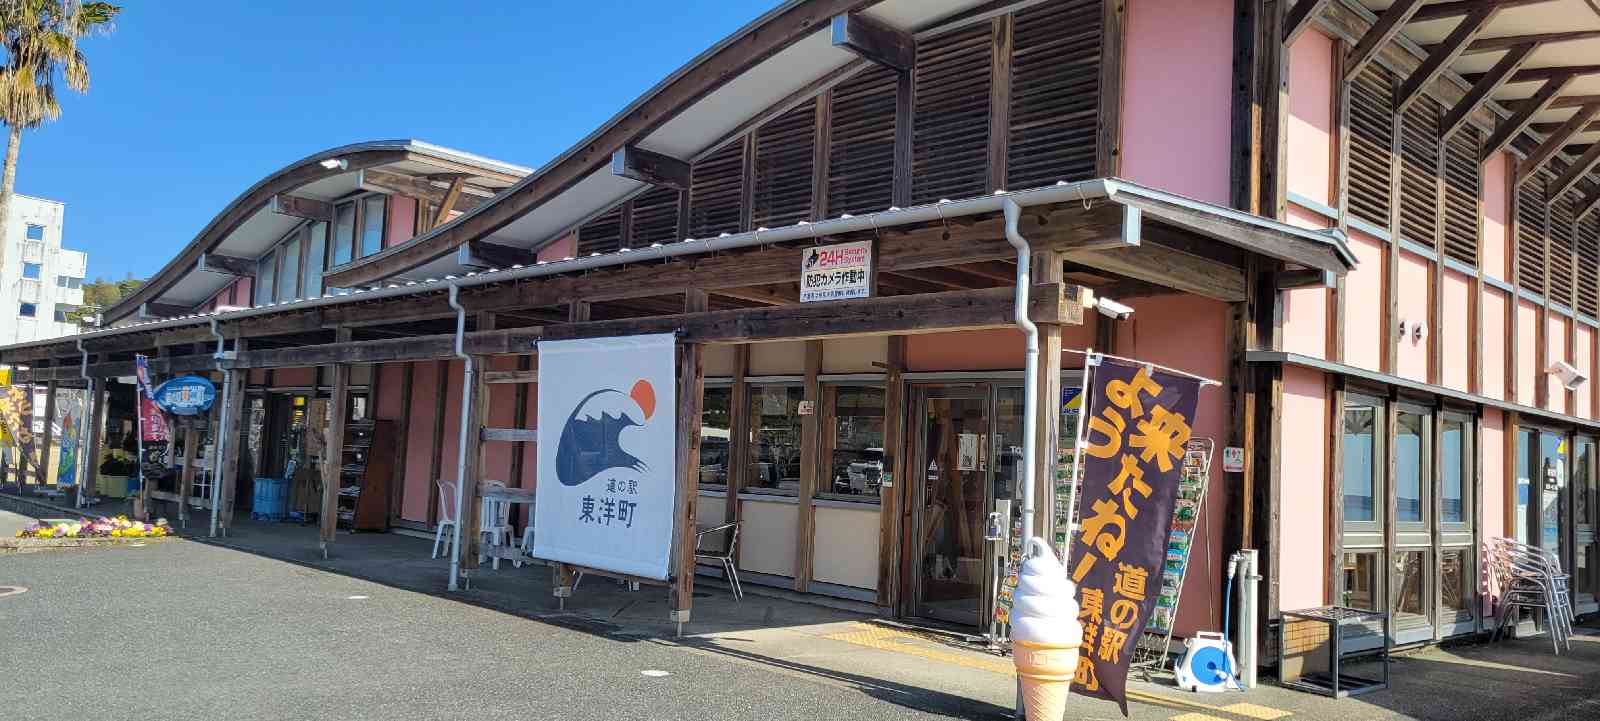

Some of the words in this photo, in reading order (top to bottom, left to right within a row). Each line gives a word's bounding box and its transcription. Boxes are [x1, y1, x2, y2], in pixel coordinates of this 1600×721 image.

[820, 248, 843, 266] 24H
[806, 268, 865, 288] 防犯カメラ作動中
[606, 478, 638, 495] 道の駅
[578, 494, 637, 529] 東洋町
[1097, 561, 1148, 665] 道の駅
